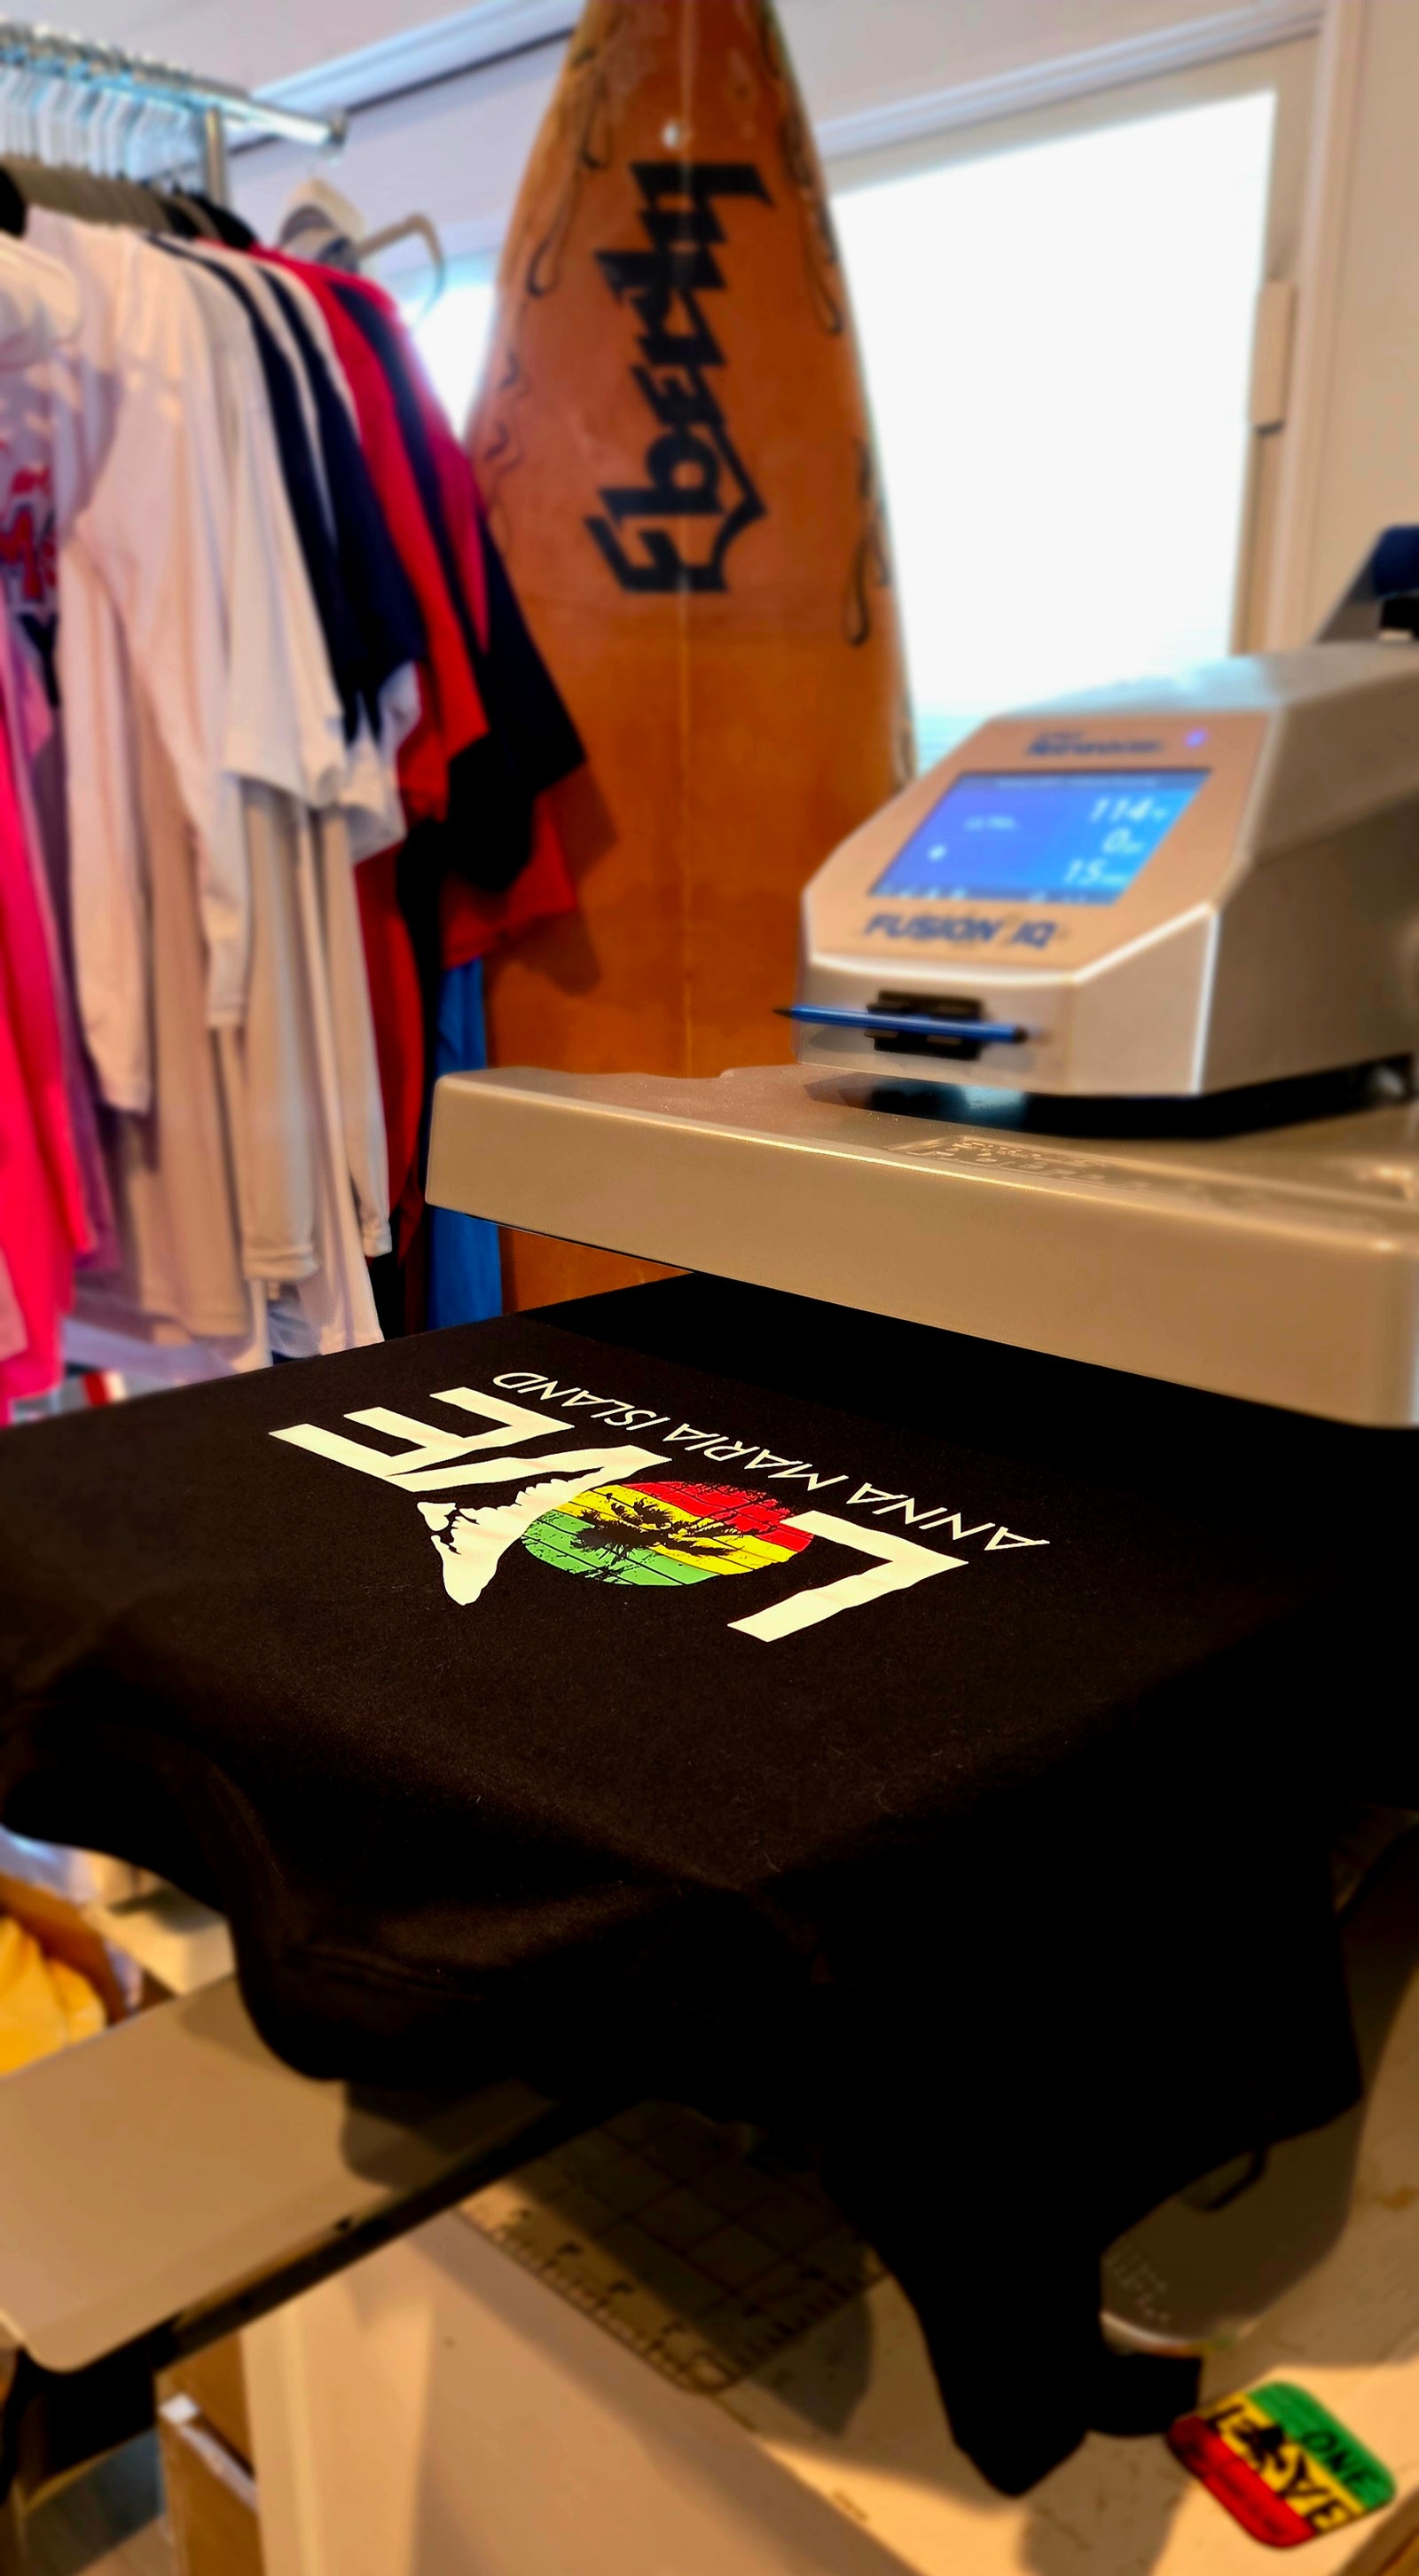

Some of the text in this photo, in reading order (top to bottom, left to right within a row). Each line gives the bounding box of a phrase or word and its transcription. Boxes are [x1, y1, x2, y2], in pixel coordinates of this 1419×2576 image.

[1089, 797, 1152, 824] 114
[863, 913, 1058, 950] FUSION IQ
[492, 1371, 1051, 1551] ANNA MARIA ISLAND
